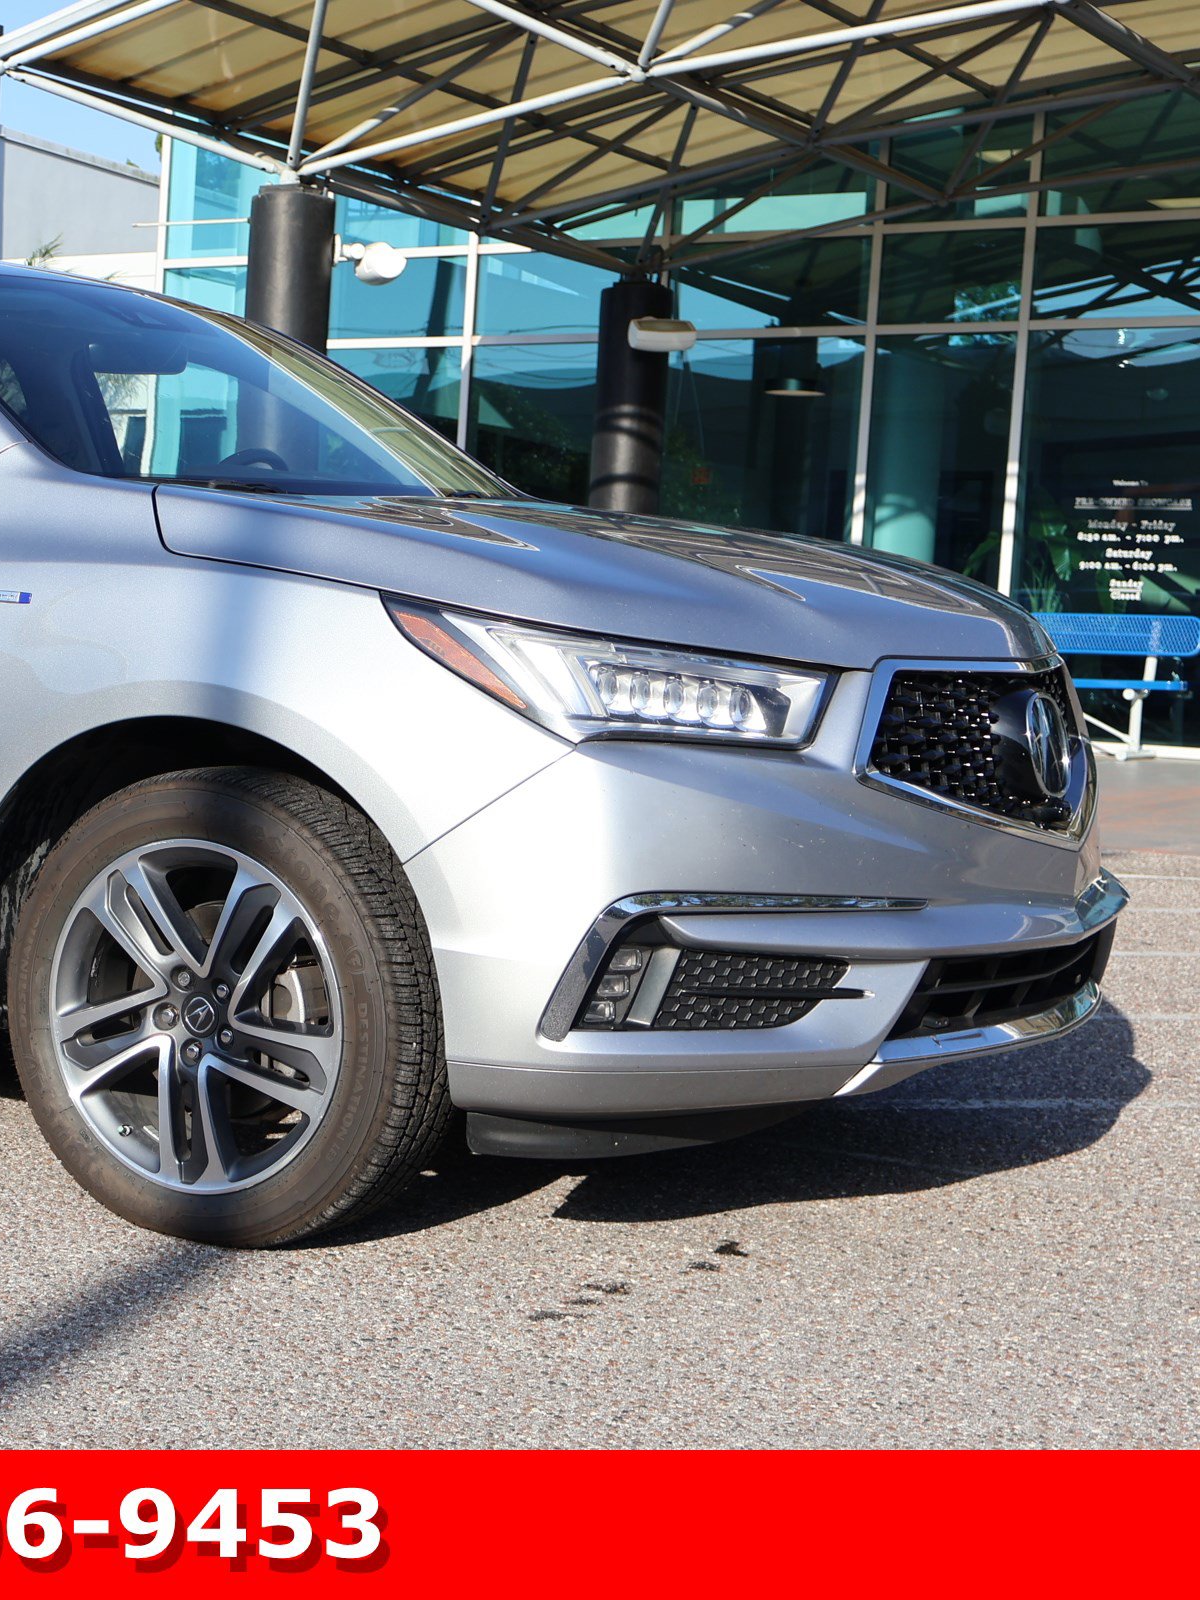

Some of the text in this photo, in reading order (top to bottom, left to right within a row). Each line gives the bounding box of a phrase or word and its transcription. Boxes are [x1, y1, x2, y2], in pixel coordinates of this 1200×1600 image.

[1088, 519, 1128, 532] Monday
[1140, 519, 1176, 532] Friday
[1077, 531, 1100, 543] 8:30
[1101, 533, 1121, 542] am.
[1136, 533, 1160, 544] 7:00
[1164, 534, 1185, 545] pm.
[1105, 547, 1153, 561] Saturday
[1078, 560, 1102, 571] 9:00
[1103, 561, 1123, 570] am.
[1157, 562, 1178, 573] pm.
[1109, 578, 1144, 590] Sunday
[1110, 591, 1141, 601] Closed
[336, 1002, 368, 1141] DESTINATION
